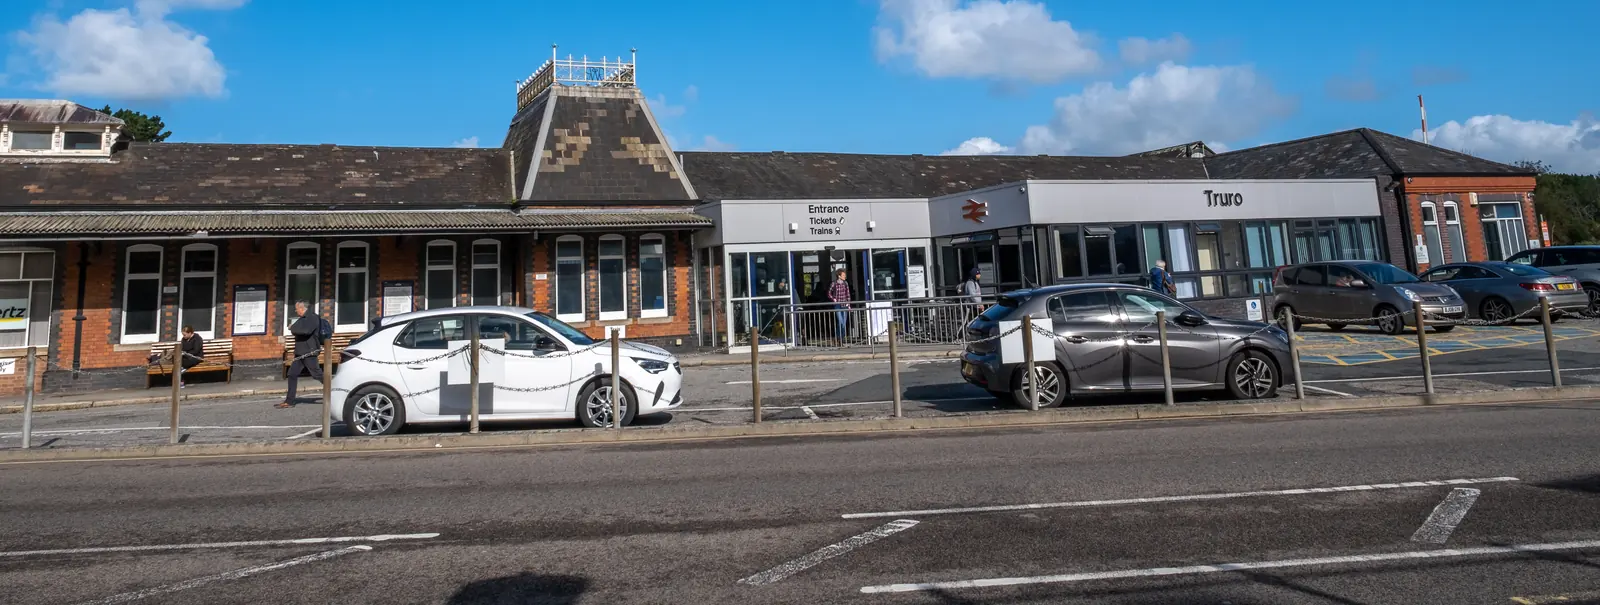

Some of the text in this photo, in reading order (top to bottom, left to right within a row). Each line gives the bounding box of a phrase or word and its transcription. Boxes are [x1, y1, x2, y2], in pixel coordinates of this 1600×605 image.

[1203, 189, 1243, 207] Truro
[808, 204, 850, 214] Entrance
[809, 217, 837, 225] Tickets
[810, 227, 833, 235] Trains
